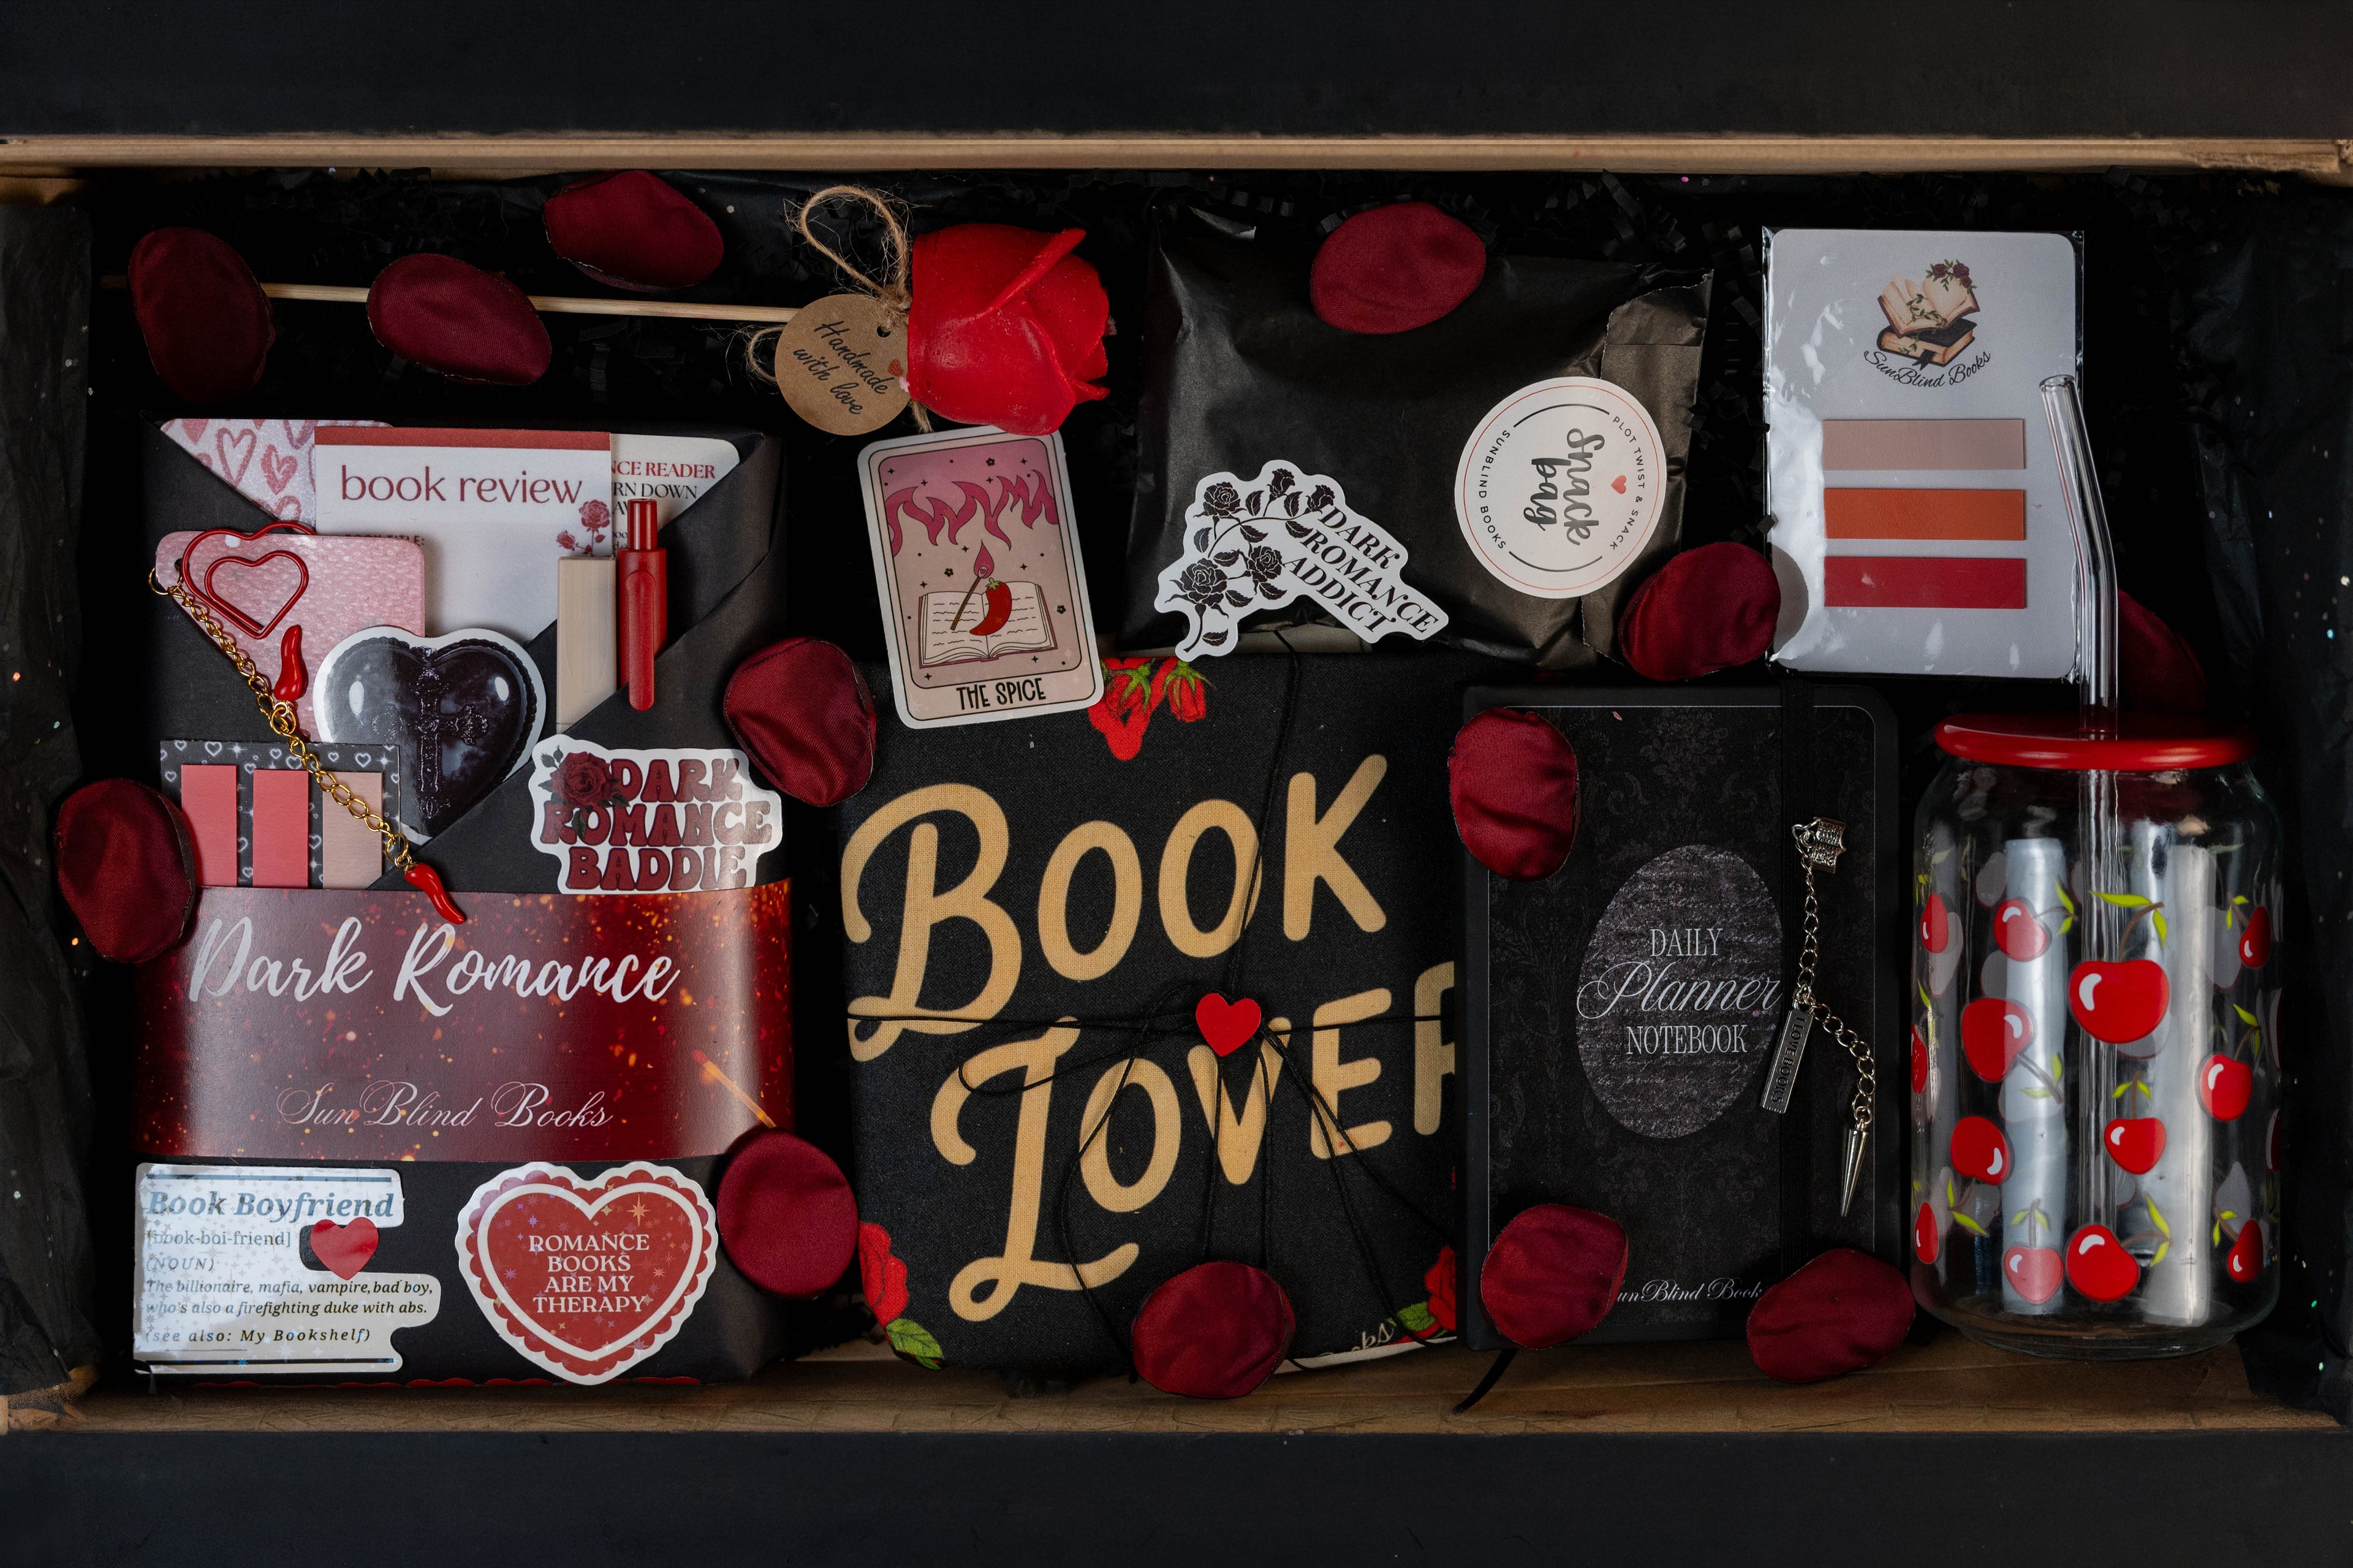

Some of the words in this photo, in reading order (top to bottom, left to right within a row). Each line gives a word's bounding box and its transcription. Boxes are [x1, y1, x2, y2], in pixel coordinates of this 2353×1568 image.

[814, 320, 895, 395] Handmade
[1948, 351, 1991, 385] Books
[793, 349, 840, 381] with
[830, 382, 863, 415] love
[1613, 416, 1637, 443] PLOT
[342, 464, 446, 502] book
[460, 470, 583, 504] review
[645, 462, 716, 479] READER
[1479, 430, 1510, 498] SUNBLIND
[1633, 447, 1645, 489] TWIST
[641, 483, 697, 499] DOWN
[1523, 458, 1572, 531] bag
[1563, 428, 1605, 545] Snack
[1317, 506, 1401, 570] DARK
[1480, 506, 1506, 549] BOOKS
[1610, 509, 1639, 550] SNACK
[1283, 556, 1397, 633] ADDICT
[1300, 529, 1440, 634] ROMANCE
[956, 684, 990, 710] THE
[995, 678, 1047, 705] SPICE
[610, 759, 743, 802] DARK
[540, 800, 773, 847] ROMANCE
[566, 846, 747, 891] BADDIE
[841, 754, 1387, 1062] BOOK
[1650, 928, 1724, 956] DAILY
[189, 916, 373, 1002] Dark
[393, 922, 681, 1017] Romance
[1577, 961, 1783, 1020] Planner
[1626, 1025, 1748, 1055] NOTEBOOK
[1785, 1024, 1805, 1056] LOVE
[1771, 1057, 1794, 1103] BOOKS
[490, 1081, 613, 1127] Books
[146, 1191, 227, 1216] Book
[233, 1191, 395, 1223] Boyfriend
[528, 1234, 650, 1252] ROMANCE
[146, 1257, 214, 1272] (NOUN)
[547, 1255, 631, 1272] BOOKS
[146, 1280, 172, 1293] The
[176, 1280, 253, 1294] billionaire,
[259, 1281, 303, 1296] mafia,
[404, 1281, 433, 1296] boy,
[544, 1276, 593, 1293] ARE
[597, 1275, 634, 1292] MY
[1616, 1279, 1705, 1303] unBlind
[1707, 1278, 1763, 1300] Book
[146, 1301, 188, 1314] who's
[191, 1301, 221, 1314] also
[225, 1305, 233, 1314] a
[237, 1301, 320, 1317] firefighting
[324, 1301, 358, 1314] duke
[363, 1301, 395, 1314] with
[399, 1301, 427, 1314] abs.
[532, 1296, 645, 1313] THERAPY
[146, 1330, 180, 1343] (see
[189, 1329, 232, 1342] also:
[240, 1329, 265, 1344] My
[273, 1328, 370, 1344] Bookshelf)
